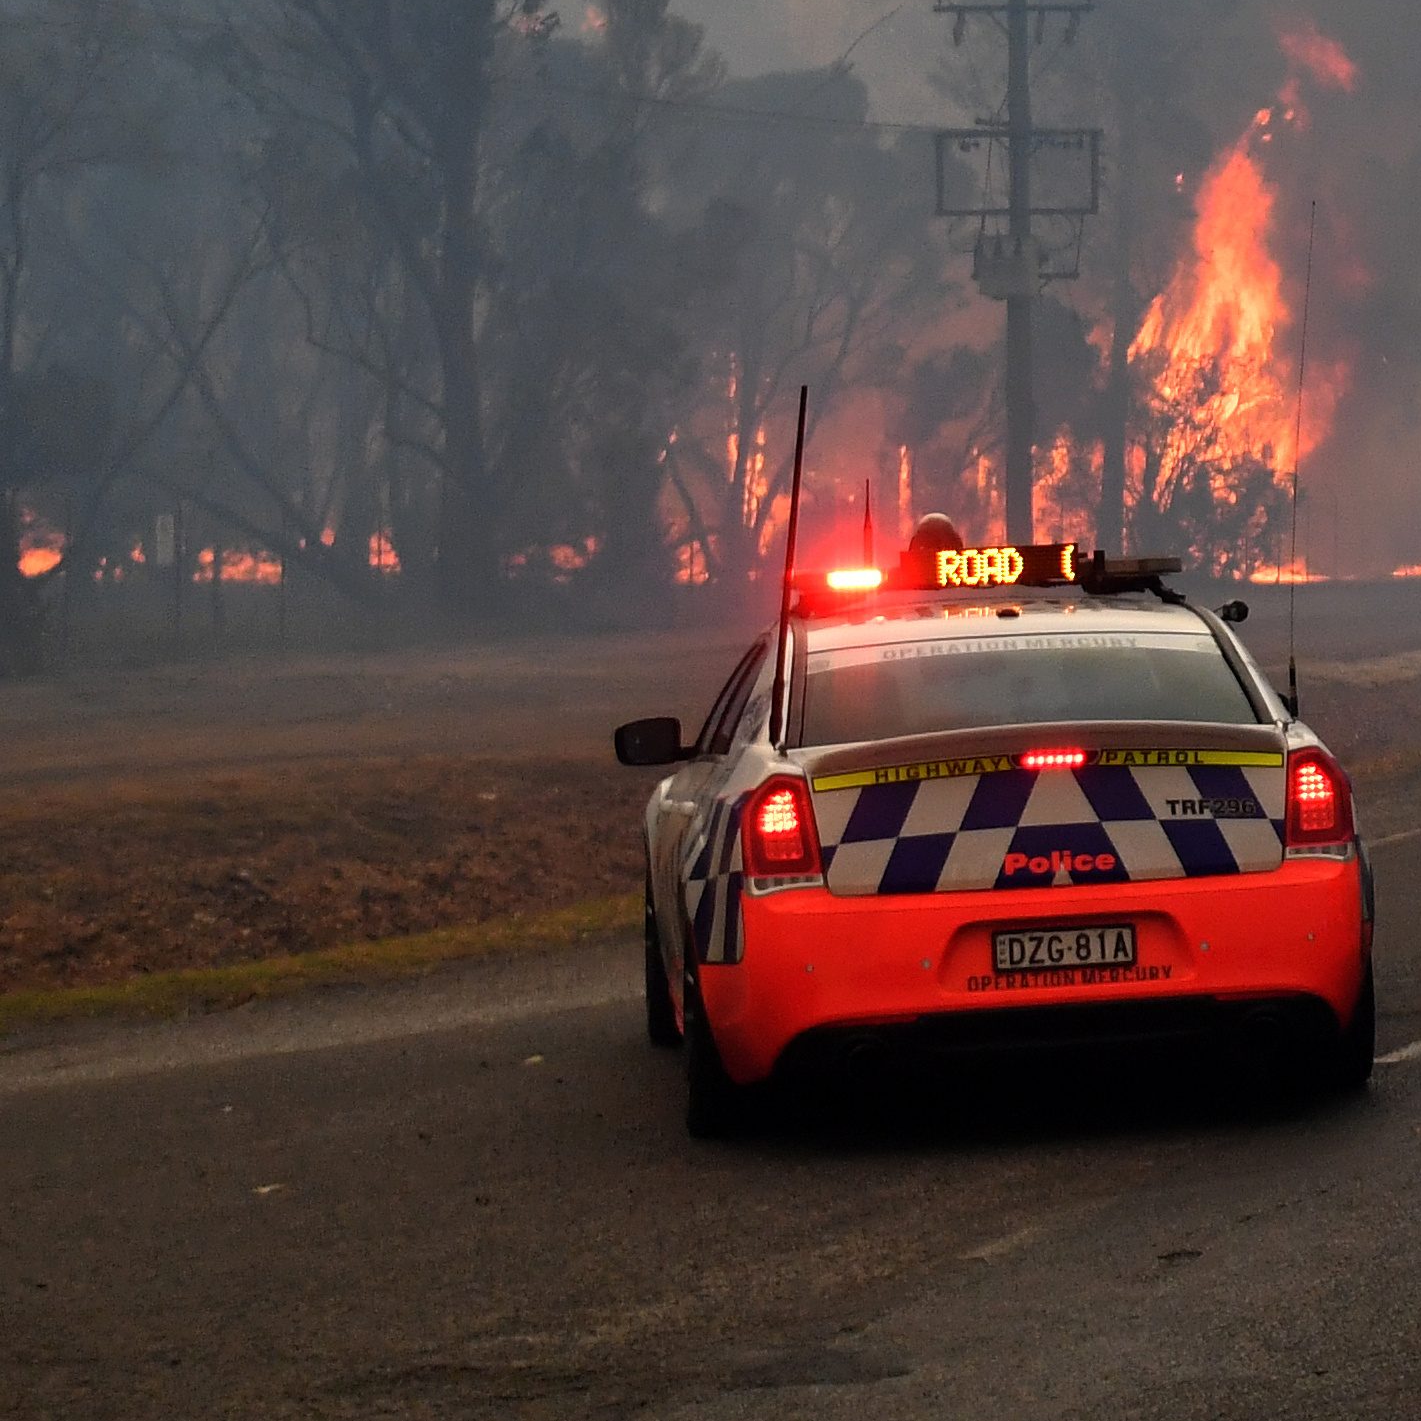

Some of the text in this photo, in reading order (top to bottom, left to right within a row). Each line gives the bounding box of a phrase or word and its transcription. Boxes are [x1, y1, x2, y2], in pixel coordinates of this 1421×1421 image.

[937, 547, 1023, 586] ROAD
[883, 638, 1018, 660] OPERATION
[874, 750, 1204, 783] HIGHWAY PATROL
[1166, 799, 1255, 816] TRF296
[1004, 850, 1116, 875] Police
[967, 966, 1173, 992] OPERATION MERCURY
